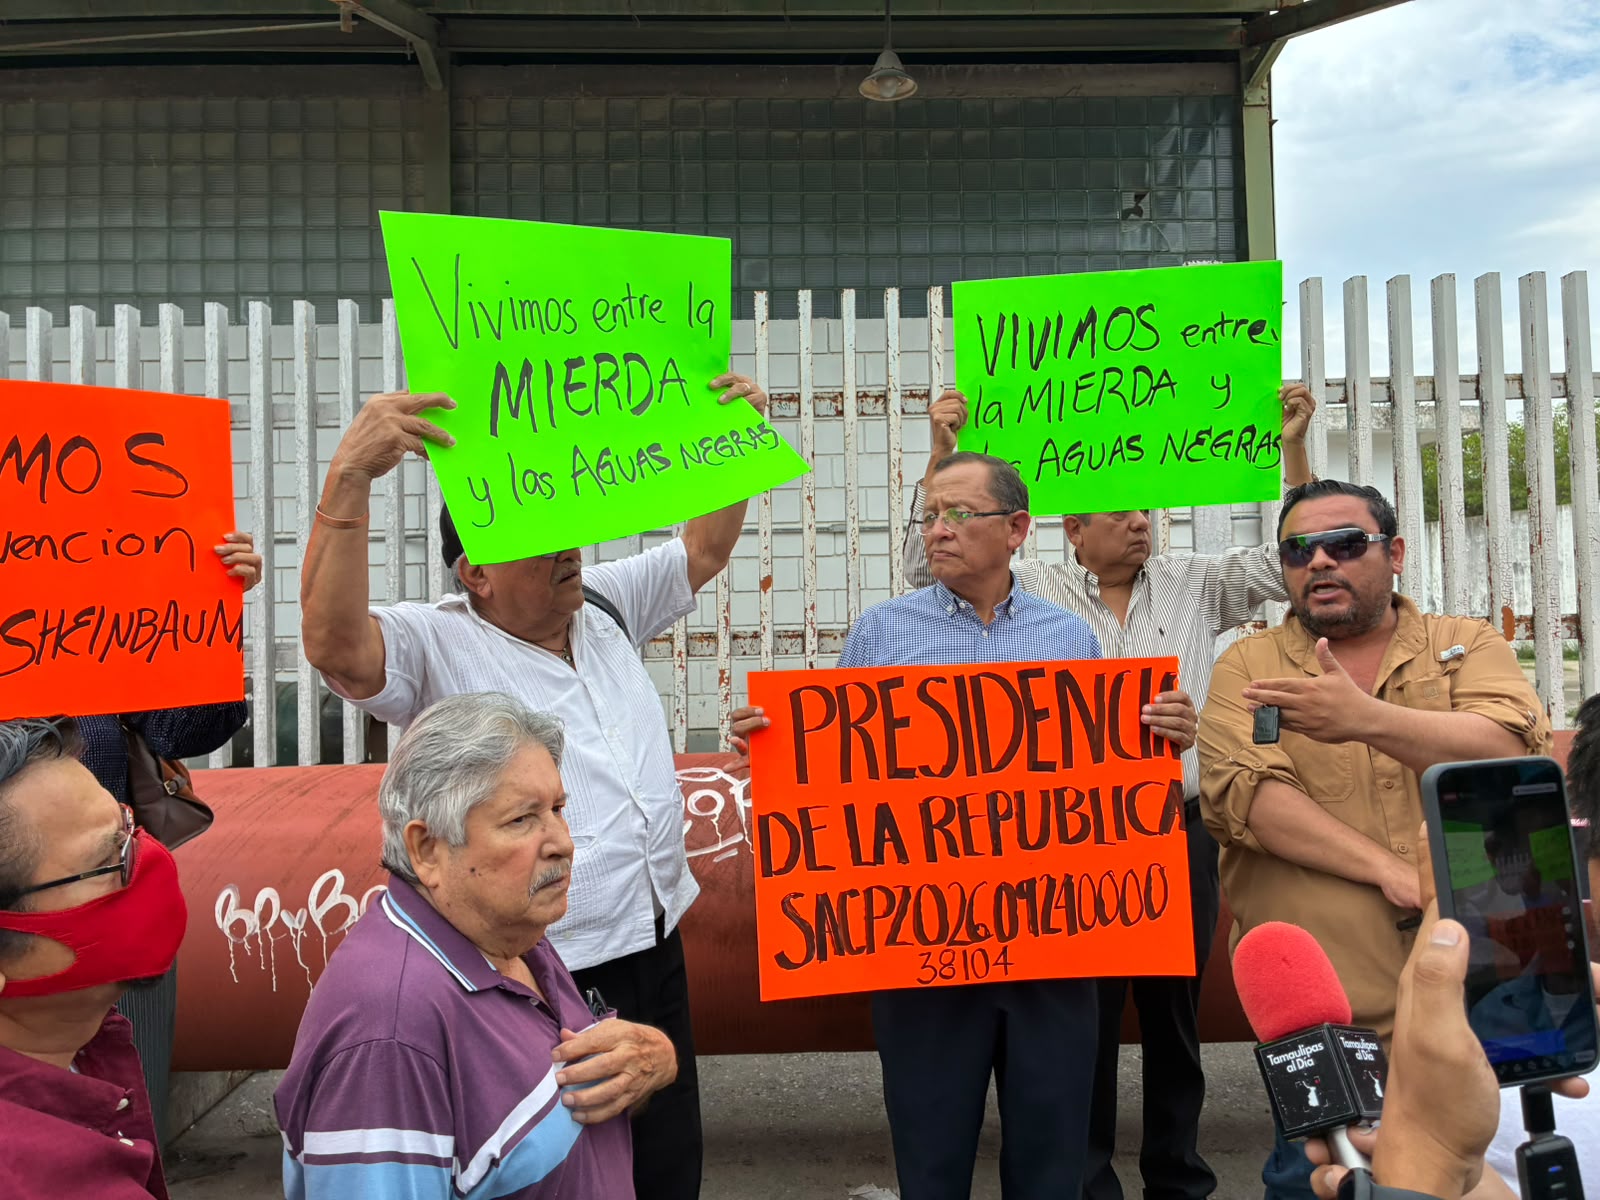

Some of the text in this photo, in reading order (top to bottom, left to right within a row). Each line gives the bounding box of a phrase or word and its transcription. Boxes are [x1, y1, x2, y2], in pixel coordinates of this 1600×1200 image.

[411, 254, 715, 350] Vivimos entre la
[976, 303, 1161, 377] VIVIMOS
[489, 352, 690, 438] MIERDA
[974, 365, 1232, 430] la MIERDA y
[467, 420, 780, 528] y las AGUAS NEGRAS
[1035, 434, 1145, 483] AGUAS
[1159, 423, 1282, 470] NEGRAS
[0, 599, 244, 677] SHEINBAUM
[757, 803, 837, 878] DE
[842, 802, 910, 867] LA
[918, 778, 1187, 864] REPUBLICA
[915, 945, 1015, 985] 38104
[1266, 1041, 1325, 1067] Tamaulipas
[1286, 1056, 1315, 1073] al Día
